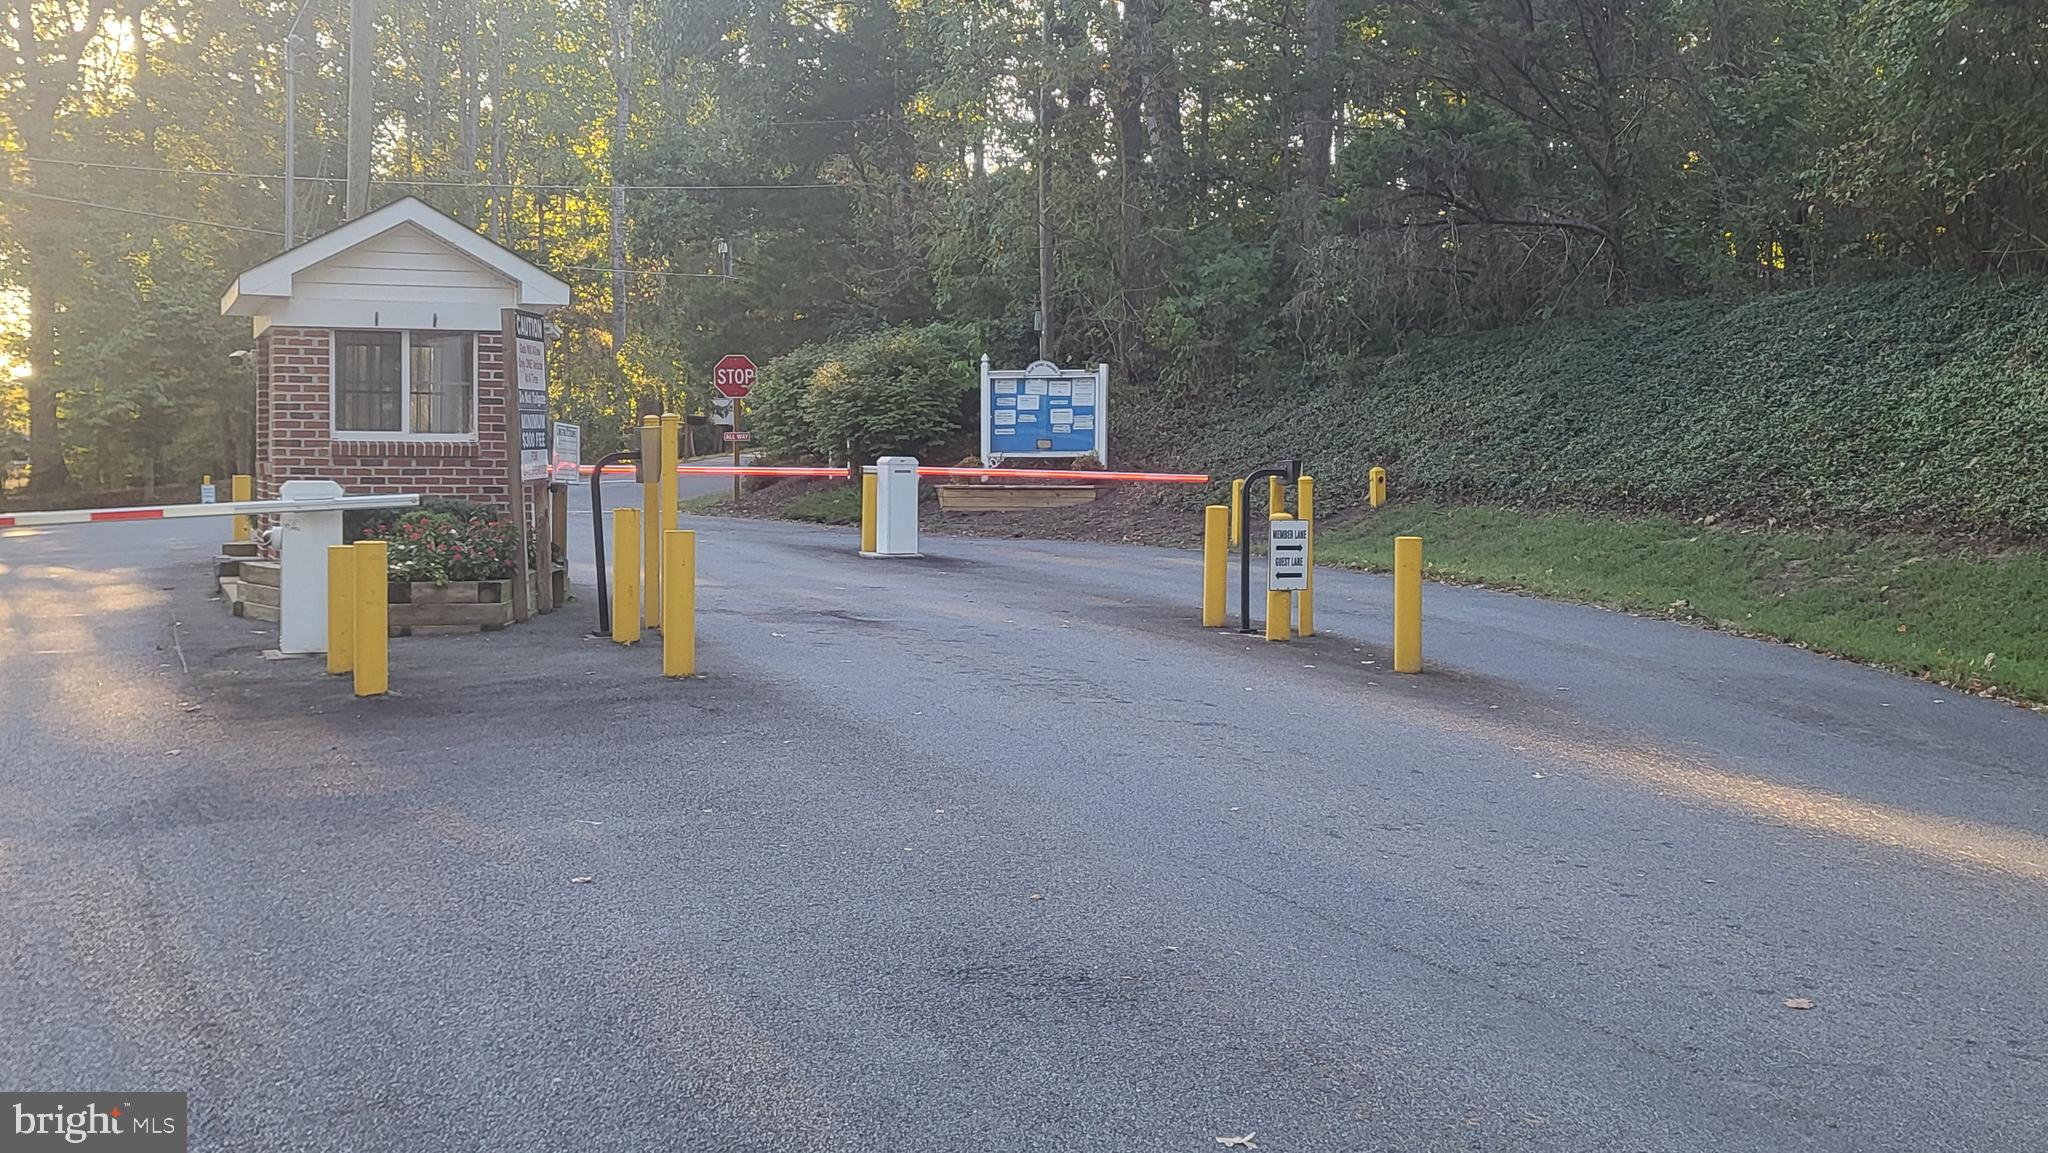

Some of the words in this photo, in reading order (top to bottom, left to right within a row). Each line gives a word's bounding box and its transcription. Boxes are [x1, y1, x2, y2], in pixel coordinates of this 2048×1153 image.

[517, 314, 543, 339] CAUTION
[717, 368, 754, 385] STOP
[519, 391, 525, 404] Do
[521, 413, 546, 429] MINIMUM
[522, 432, 535, 448] $300
[535, 432, 546, 447] FEE
[1273, 530, 1294, 539] MEMBER
[1294, 530, 1307, 539] LANE
[1275, 557, 1291, 567] GUEST
[1291, 557, 1304, 567] LANE
